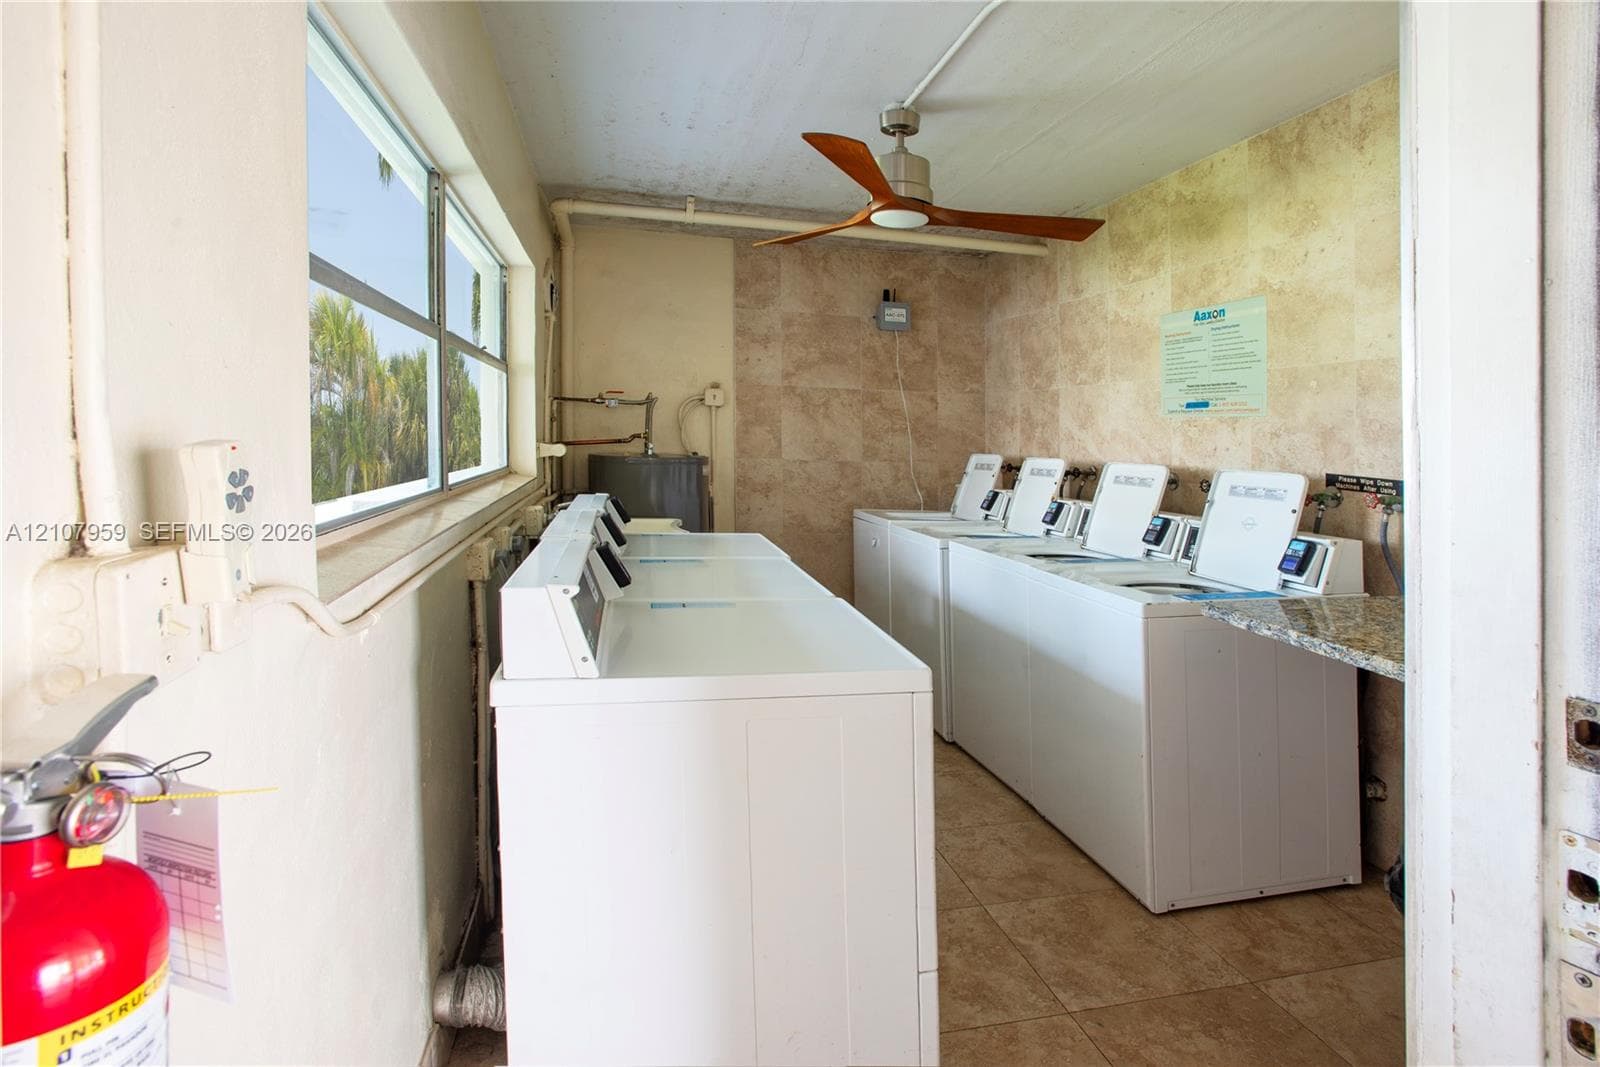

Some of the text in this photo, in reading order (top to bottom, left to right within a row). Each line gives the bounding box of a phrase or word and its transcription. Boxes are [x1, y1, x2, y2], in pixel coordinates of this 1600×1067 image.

[1193, 308, 1226, 322] Aaxon
[1335, 482, 1360, 491] Machines
[1380, 488, 1397, 496] Using
